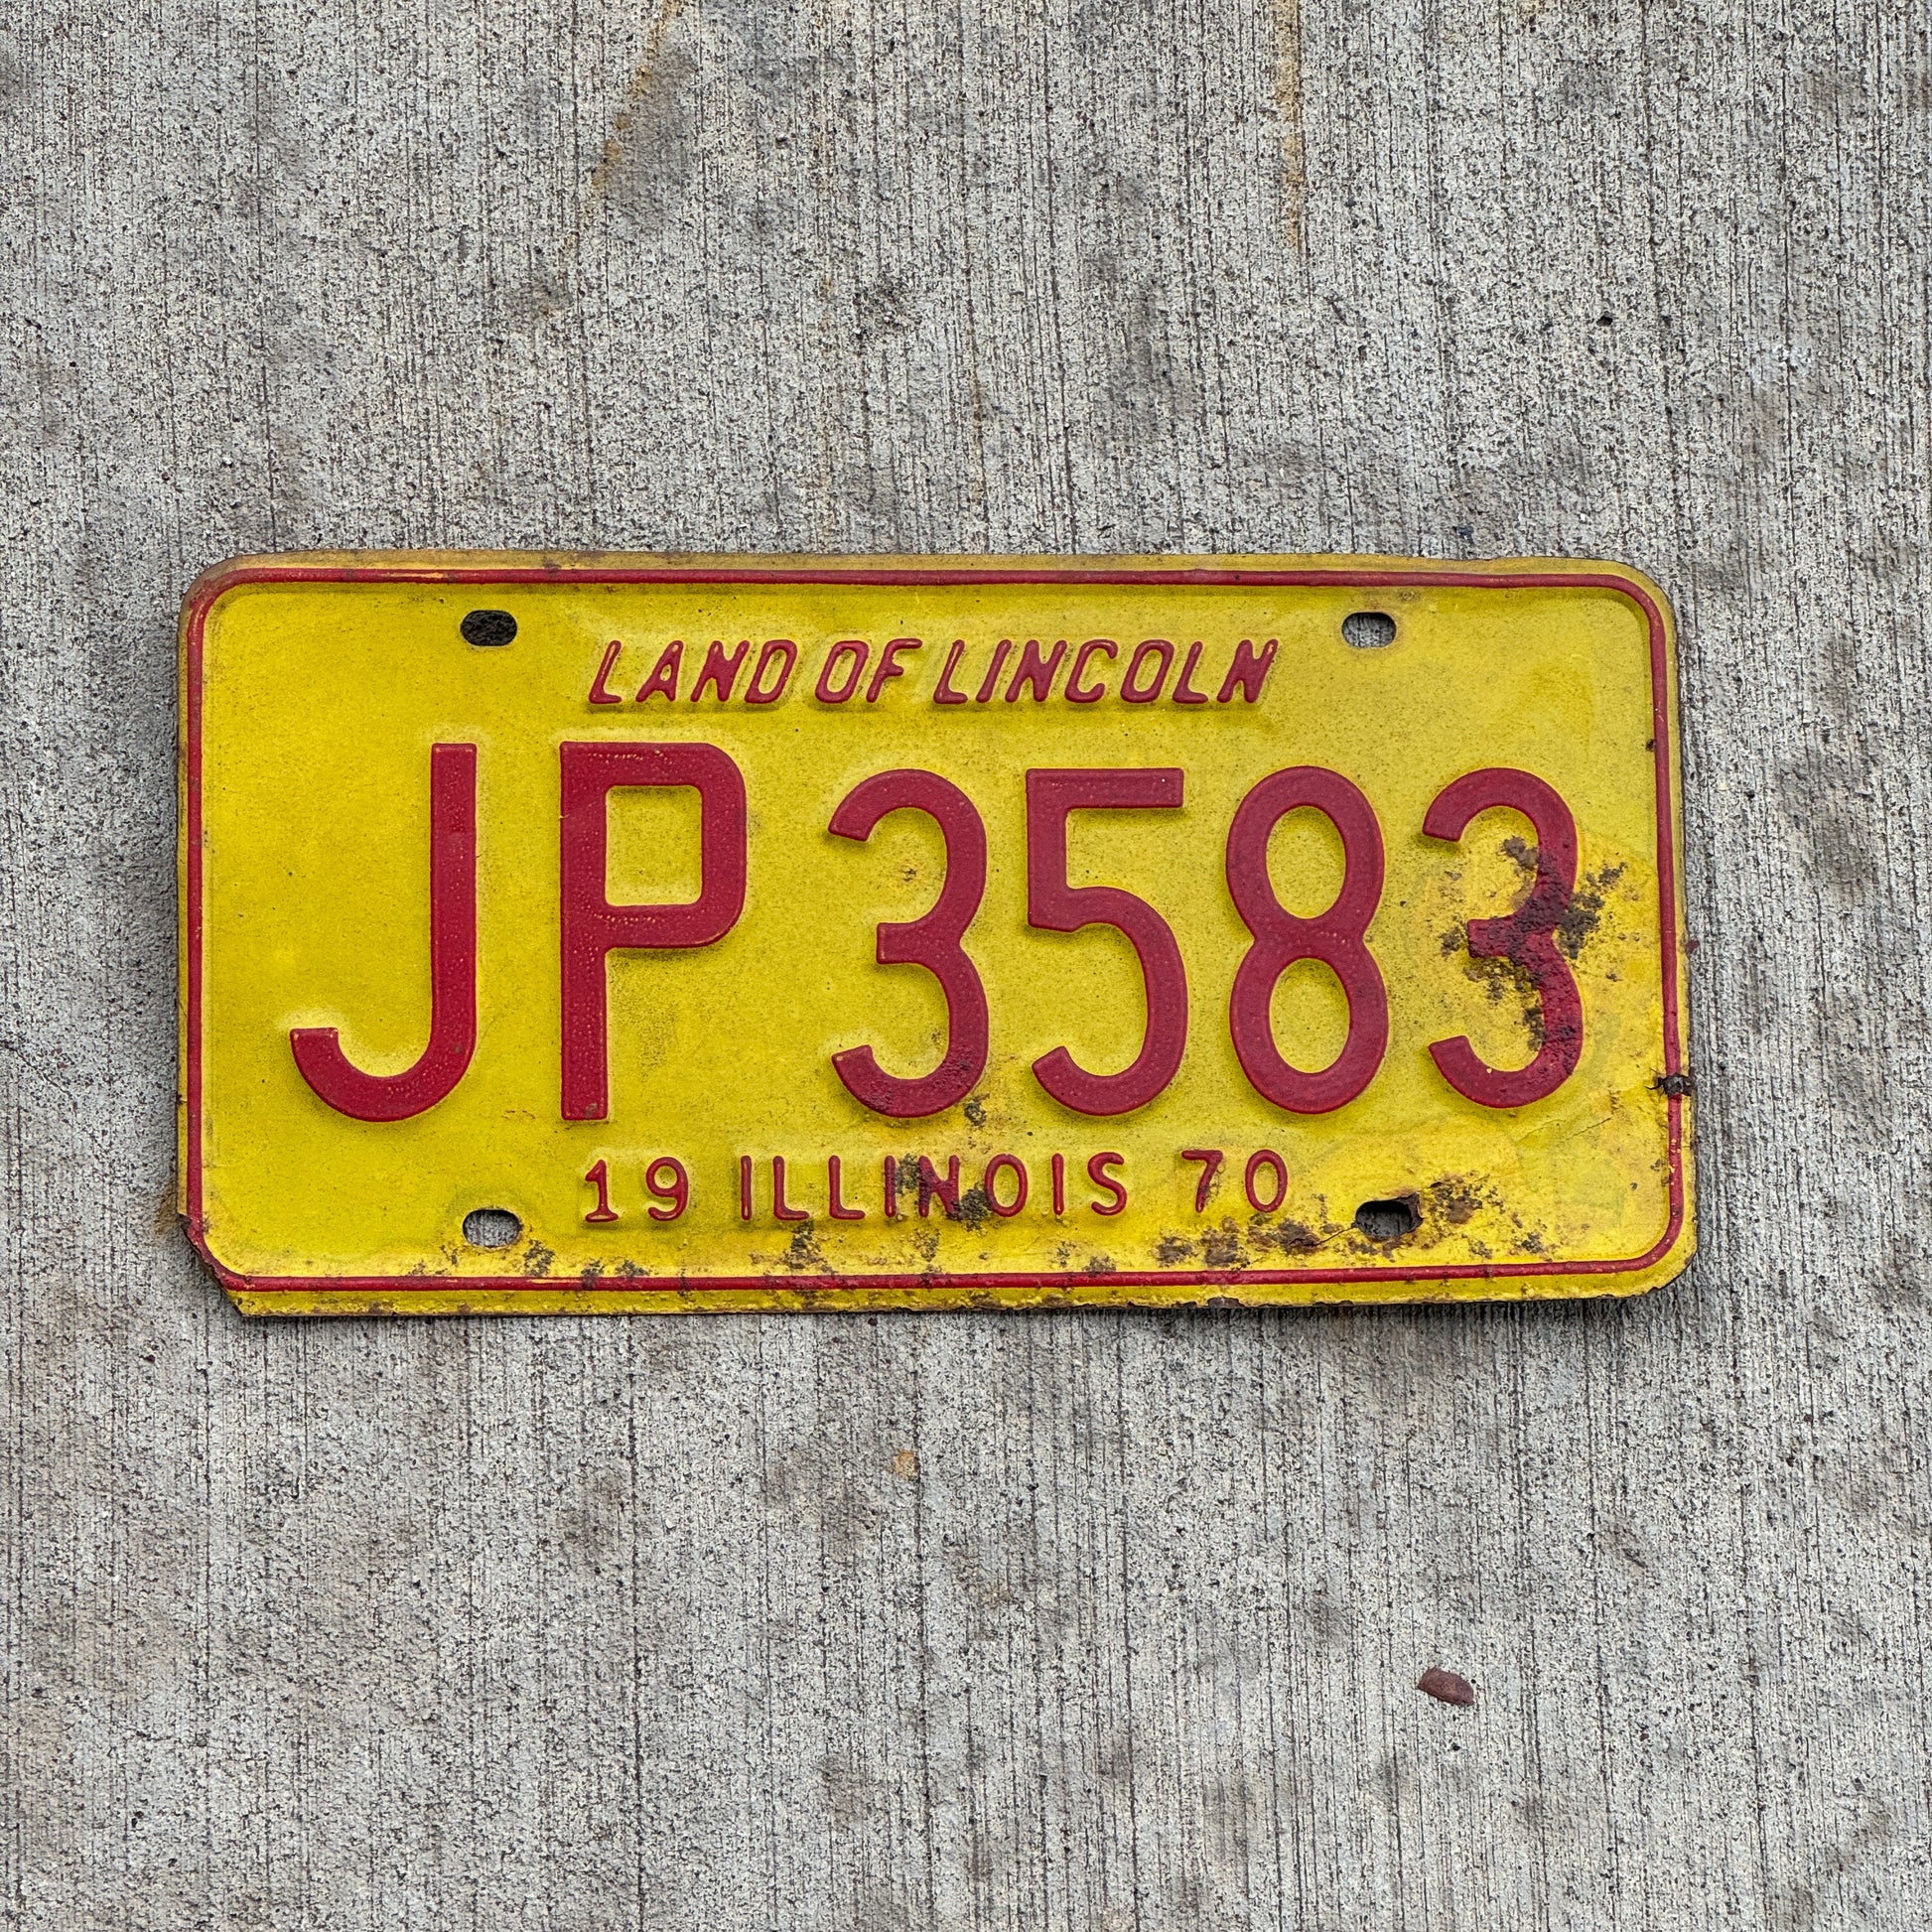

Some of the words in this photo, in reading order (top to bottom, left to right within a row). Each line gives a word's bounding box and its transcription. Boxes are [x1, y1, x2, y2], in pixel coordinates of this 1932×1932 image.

[588, 638, 798, 706] LAND
[814, 637, 923, 706] OF
[932, 637, 1280, 706] LINCOLN
[289, 740, 749, 1125] JP
[827, 764, 1586, 1121] 3583
[584, 1156, 690, 1224] 19
[740, 1152, 1129, 1222] ILLINOIS
[1180, 1148, 1290, 1216] 70
